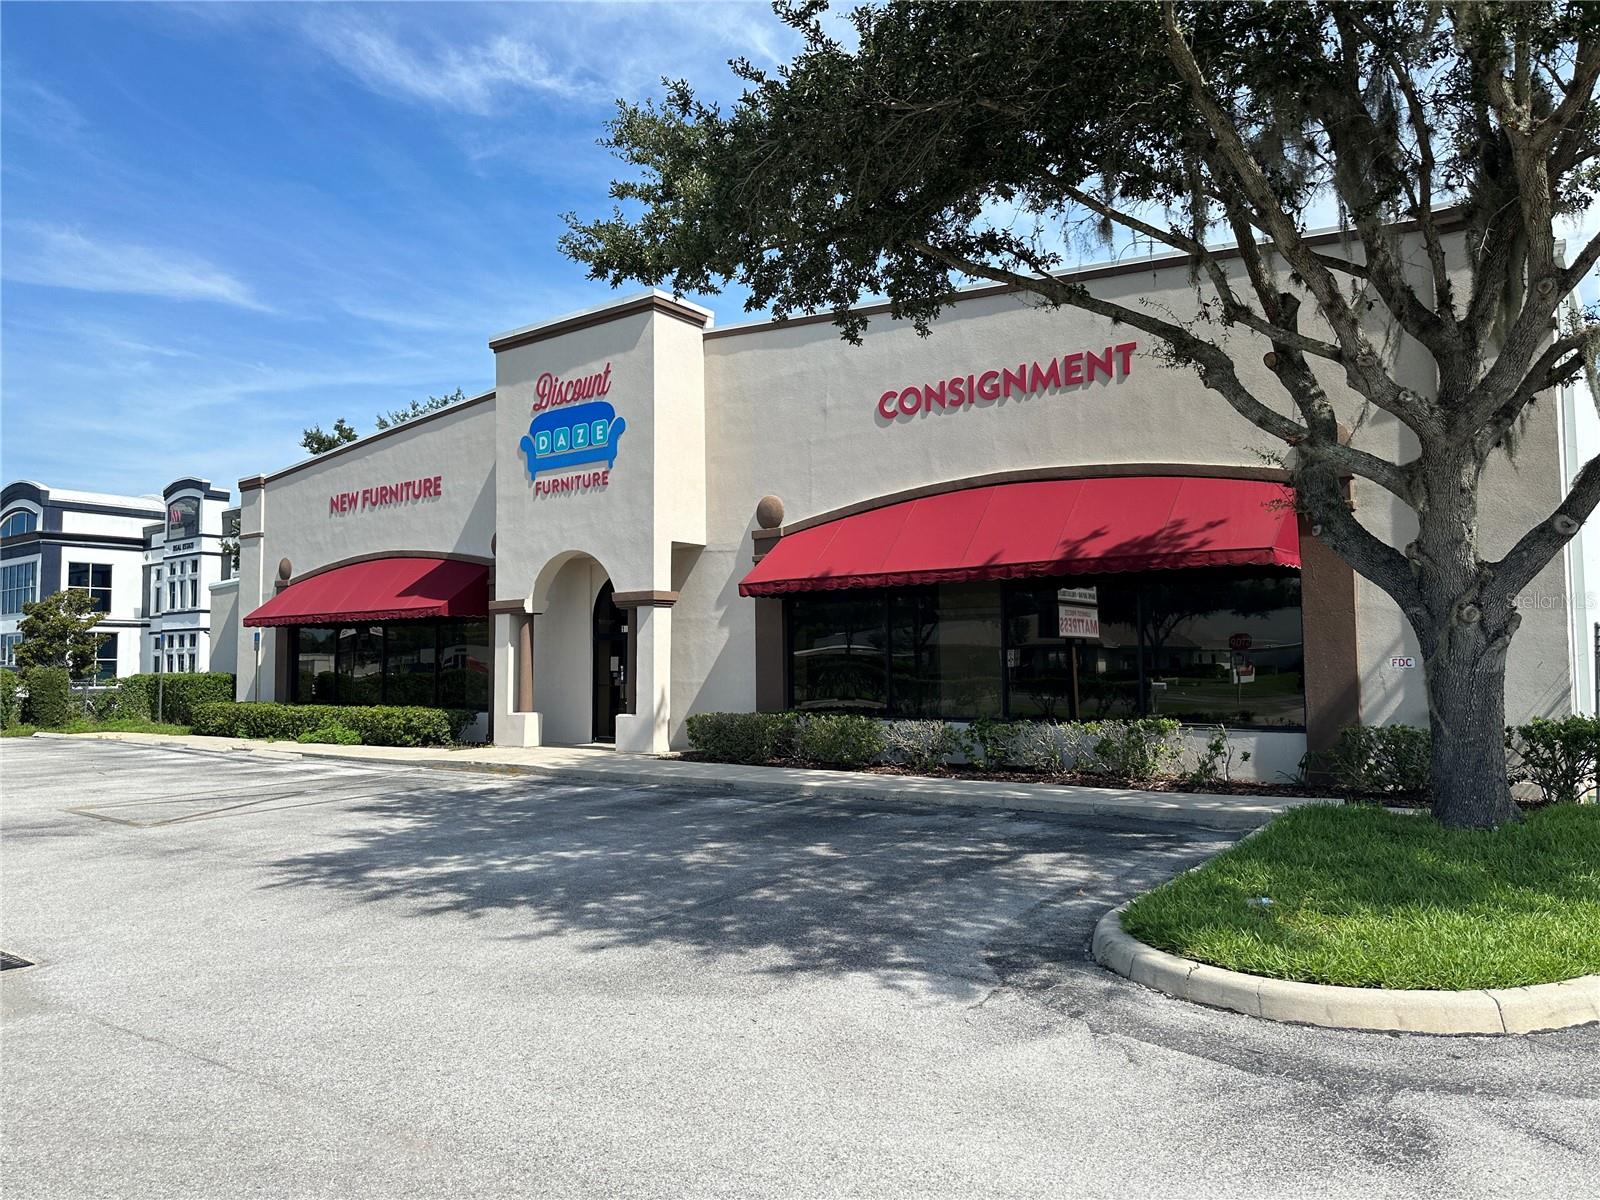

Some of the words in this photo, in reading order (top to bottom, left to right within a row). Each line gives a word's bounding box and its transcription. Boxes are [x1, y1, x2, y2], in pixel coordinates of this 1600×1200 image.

[532, 362, 612, 411] Discount
[878, 341, 1137, 420] CONSIGNMENT
[539, 425, 605, 451] DAZE
[330, 491, 359, 513] NEW
[362, 476, 442, 507] FURNITURE
[535, 471, 609, 496] FURNITURE
[172, 543, 181, 551] REAL
[182, 542, 194, 550] ESTATE
[1392, 658, 1412, 668] FDC
